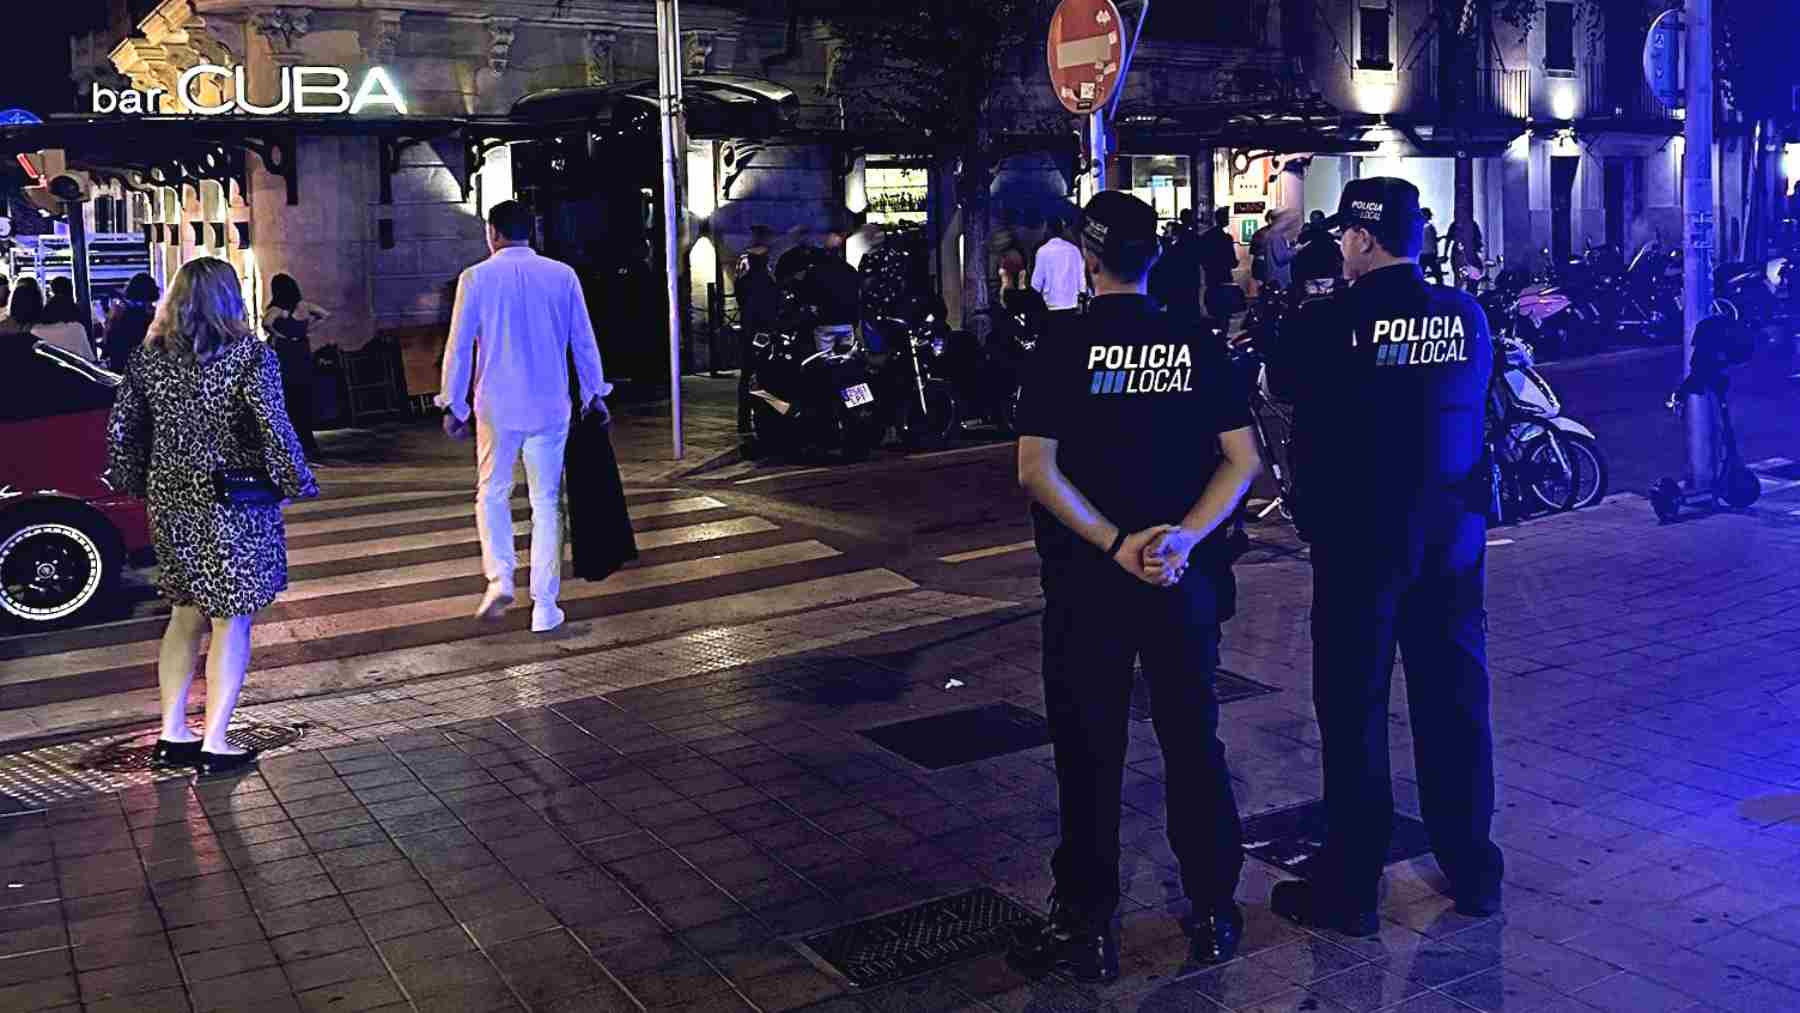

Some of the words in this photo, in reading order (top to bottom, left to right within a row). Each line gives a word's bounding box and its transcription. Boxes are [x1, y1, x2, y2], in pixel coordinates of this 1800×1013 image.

[92, 82, 162, 114] bar
[176, 64, 408, 116] CUBA
[1351, 200, 1383, 211] POLICIA
[1373, 315, 1464, 343] POLICIA
[1087, 344, 1192, 369] POLICIA
[1409, 338, 1468, 365] LOCAL
[1126, 368, 1193, 393] LOCAL
